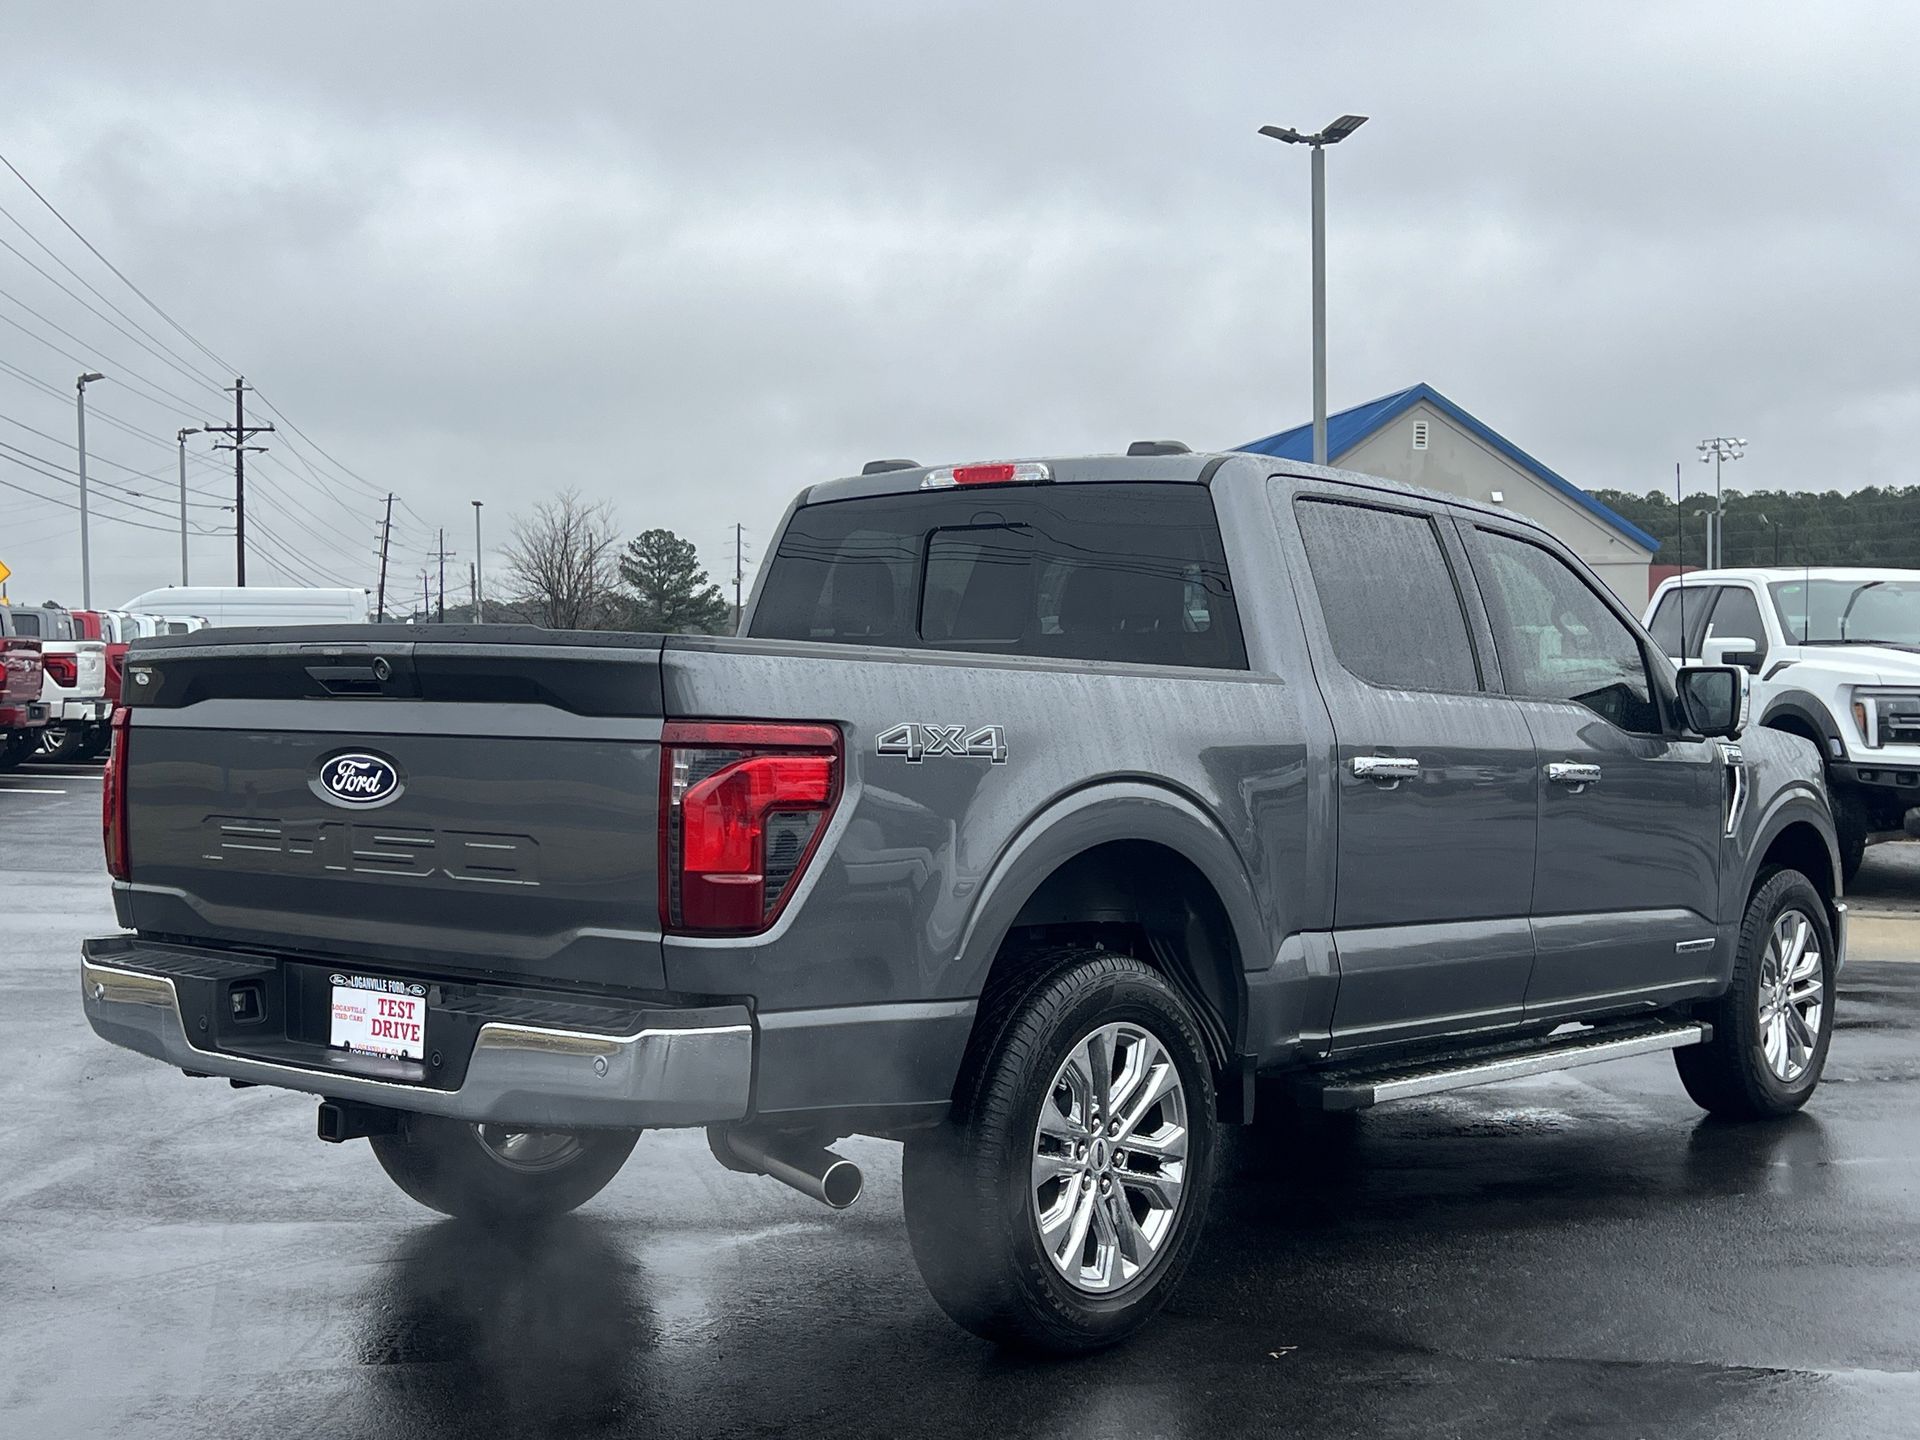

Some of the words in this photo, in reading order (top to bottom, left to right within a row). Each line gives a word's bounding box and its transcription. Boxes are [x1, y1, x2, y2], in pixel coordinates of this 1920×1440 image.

[332, 760, 382, 793] Ford
[202, 815, 540, 885] F-150
[351, 975, 388, 992] LOGANVILLE
[388, 981, 405, 994] FORD
[378, 998, 415, 1020] TEST
[371, 1019, 420, 1042] DRIVE
